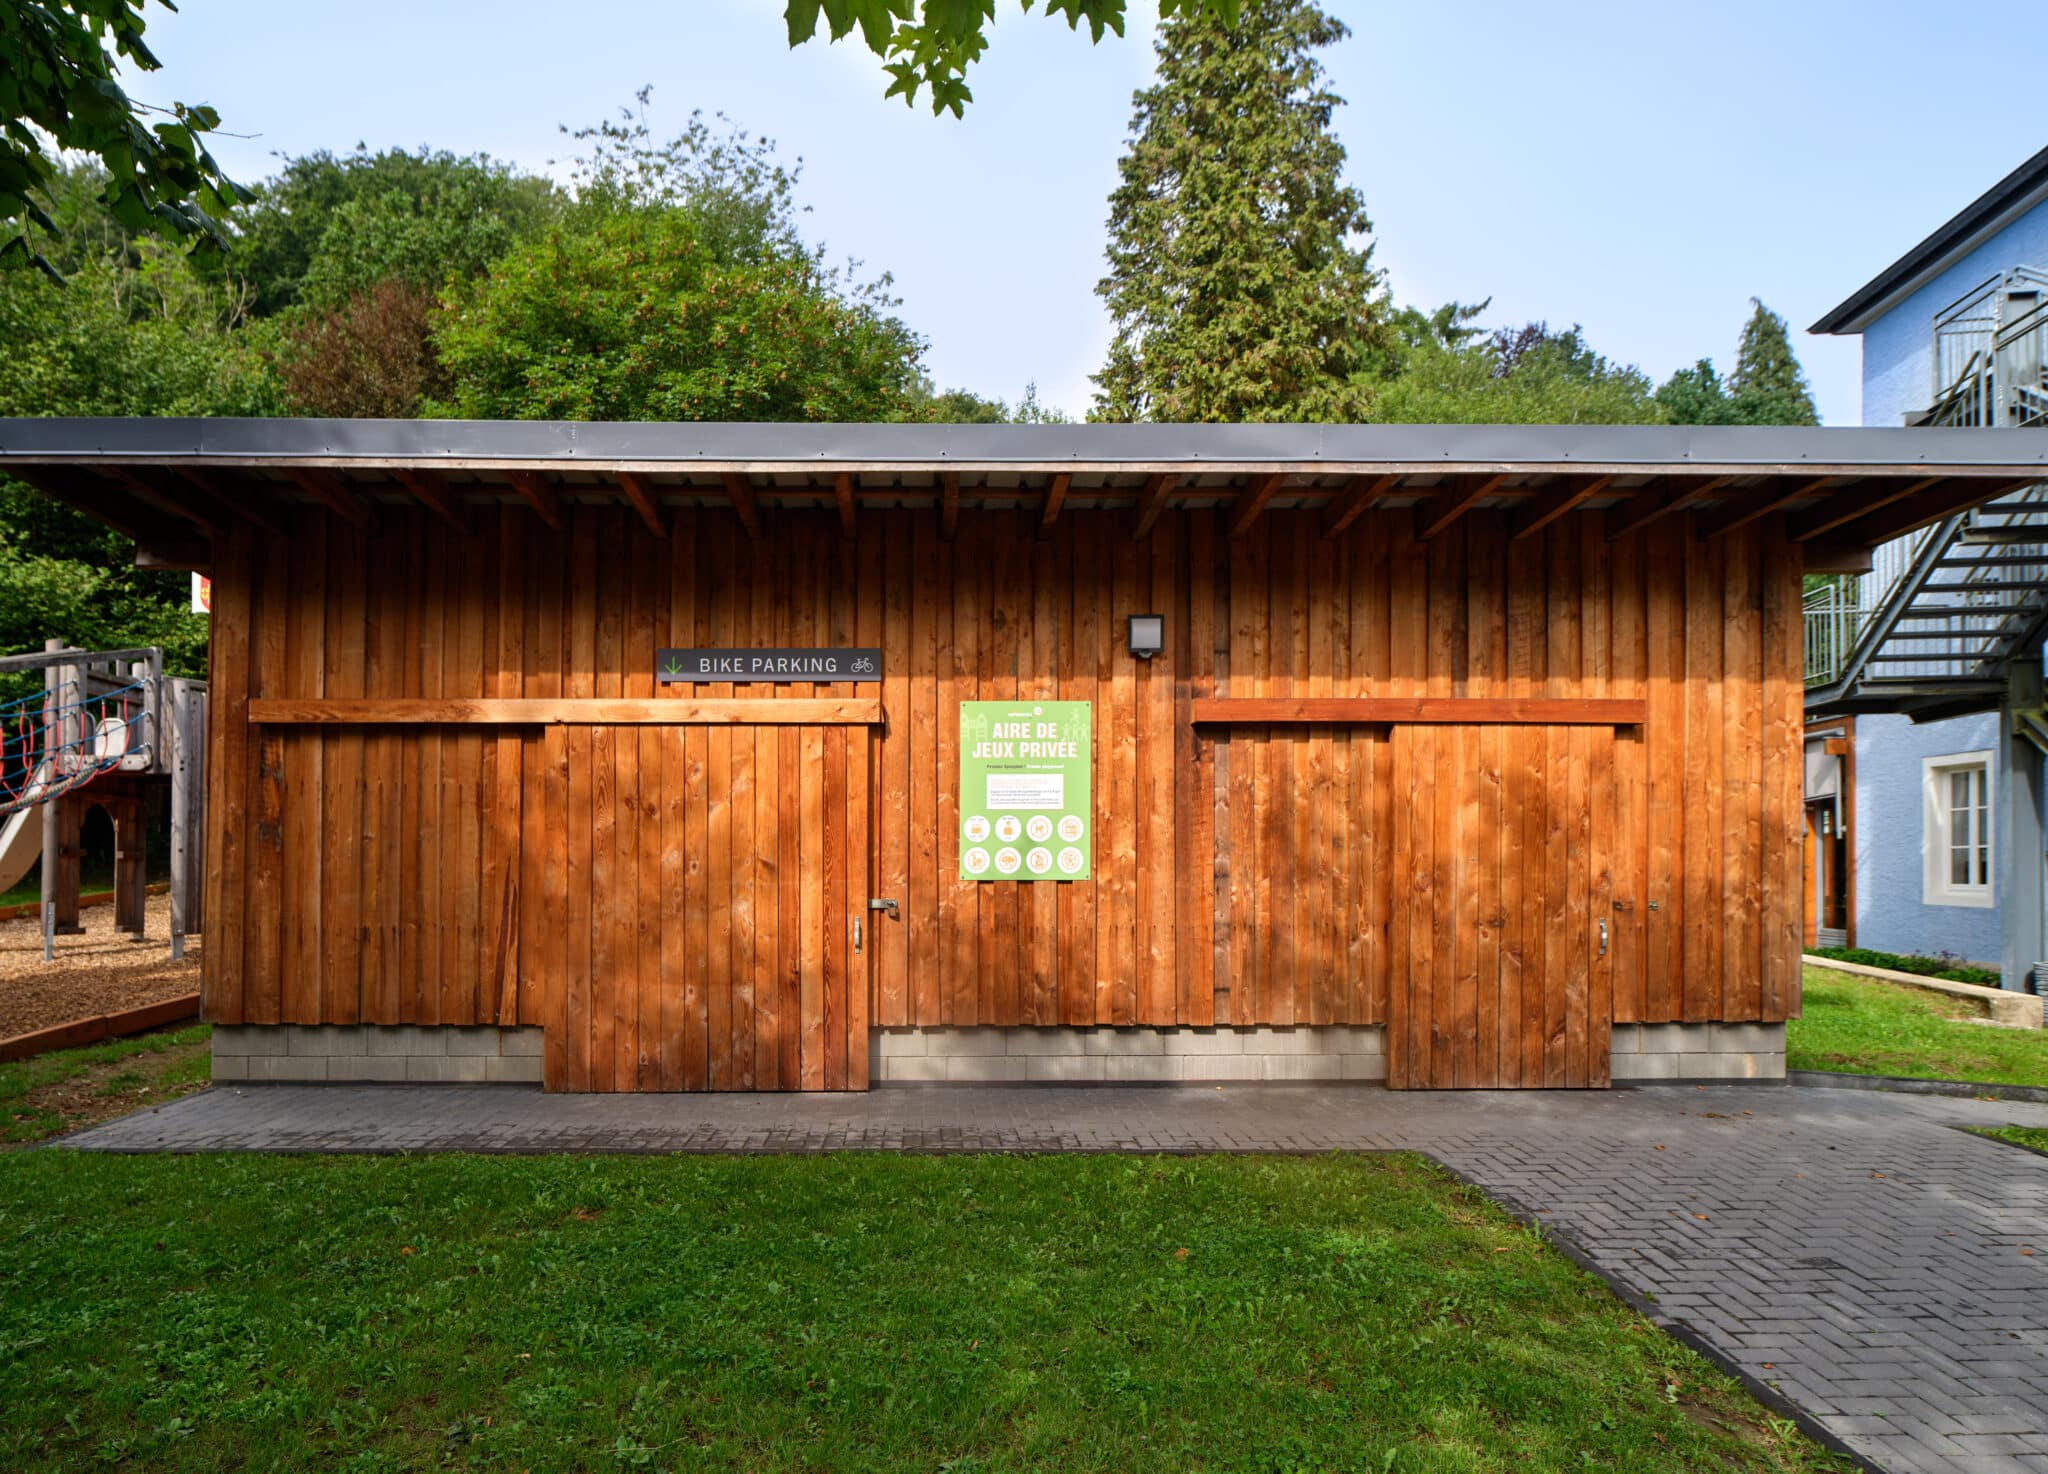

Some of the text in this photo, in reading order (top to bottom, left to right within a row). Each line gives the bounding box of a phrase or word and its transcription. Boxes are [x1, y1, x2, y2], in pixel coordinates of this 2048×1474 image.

[699, 657, 838, 673] BIKE PARKING
[992, 722, 1058, 739] AIRE DE
[972, 737, 1078, 758] JEUX PRIVÉE
